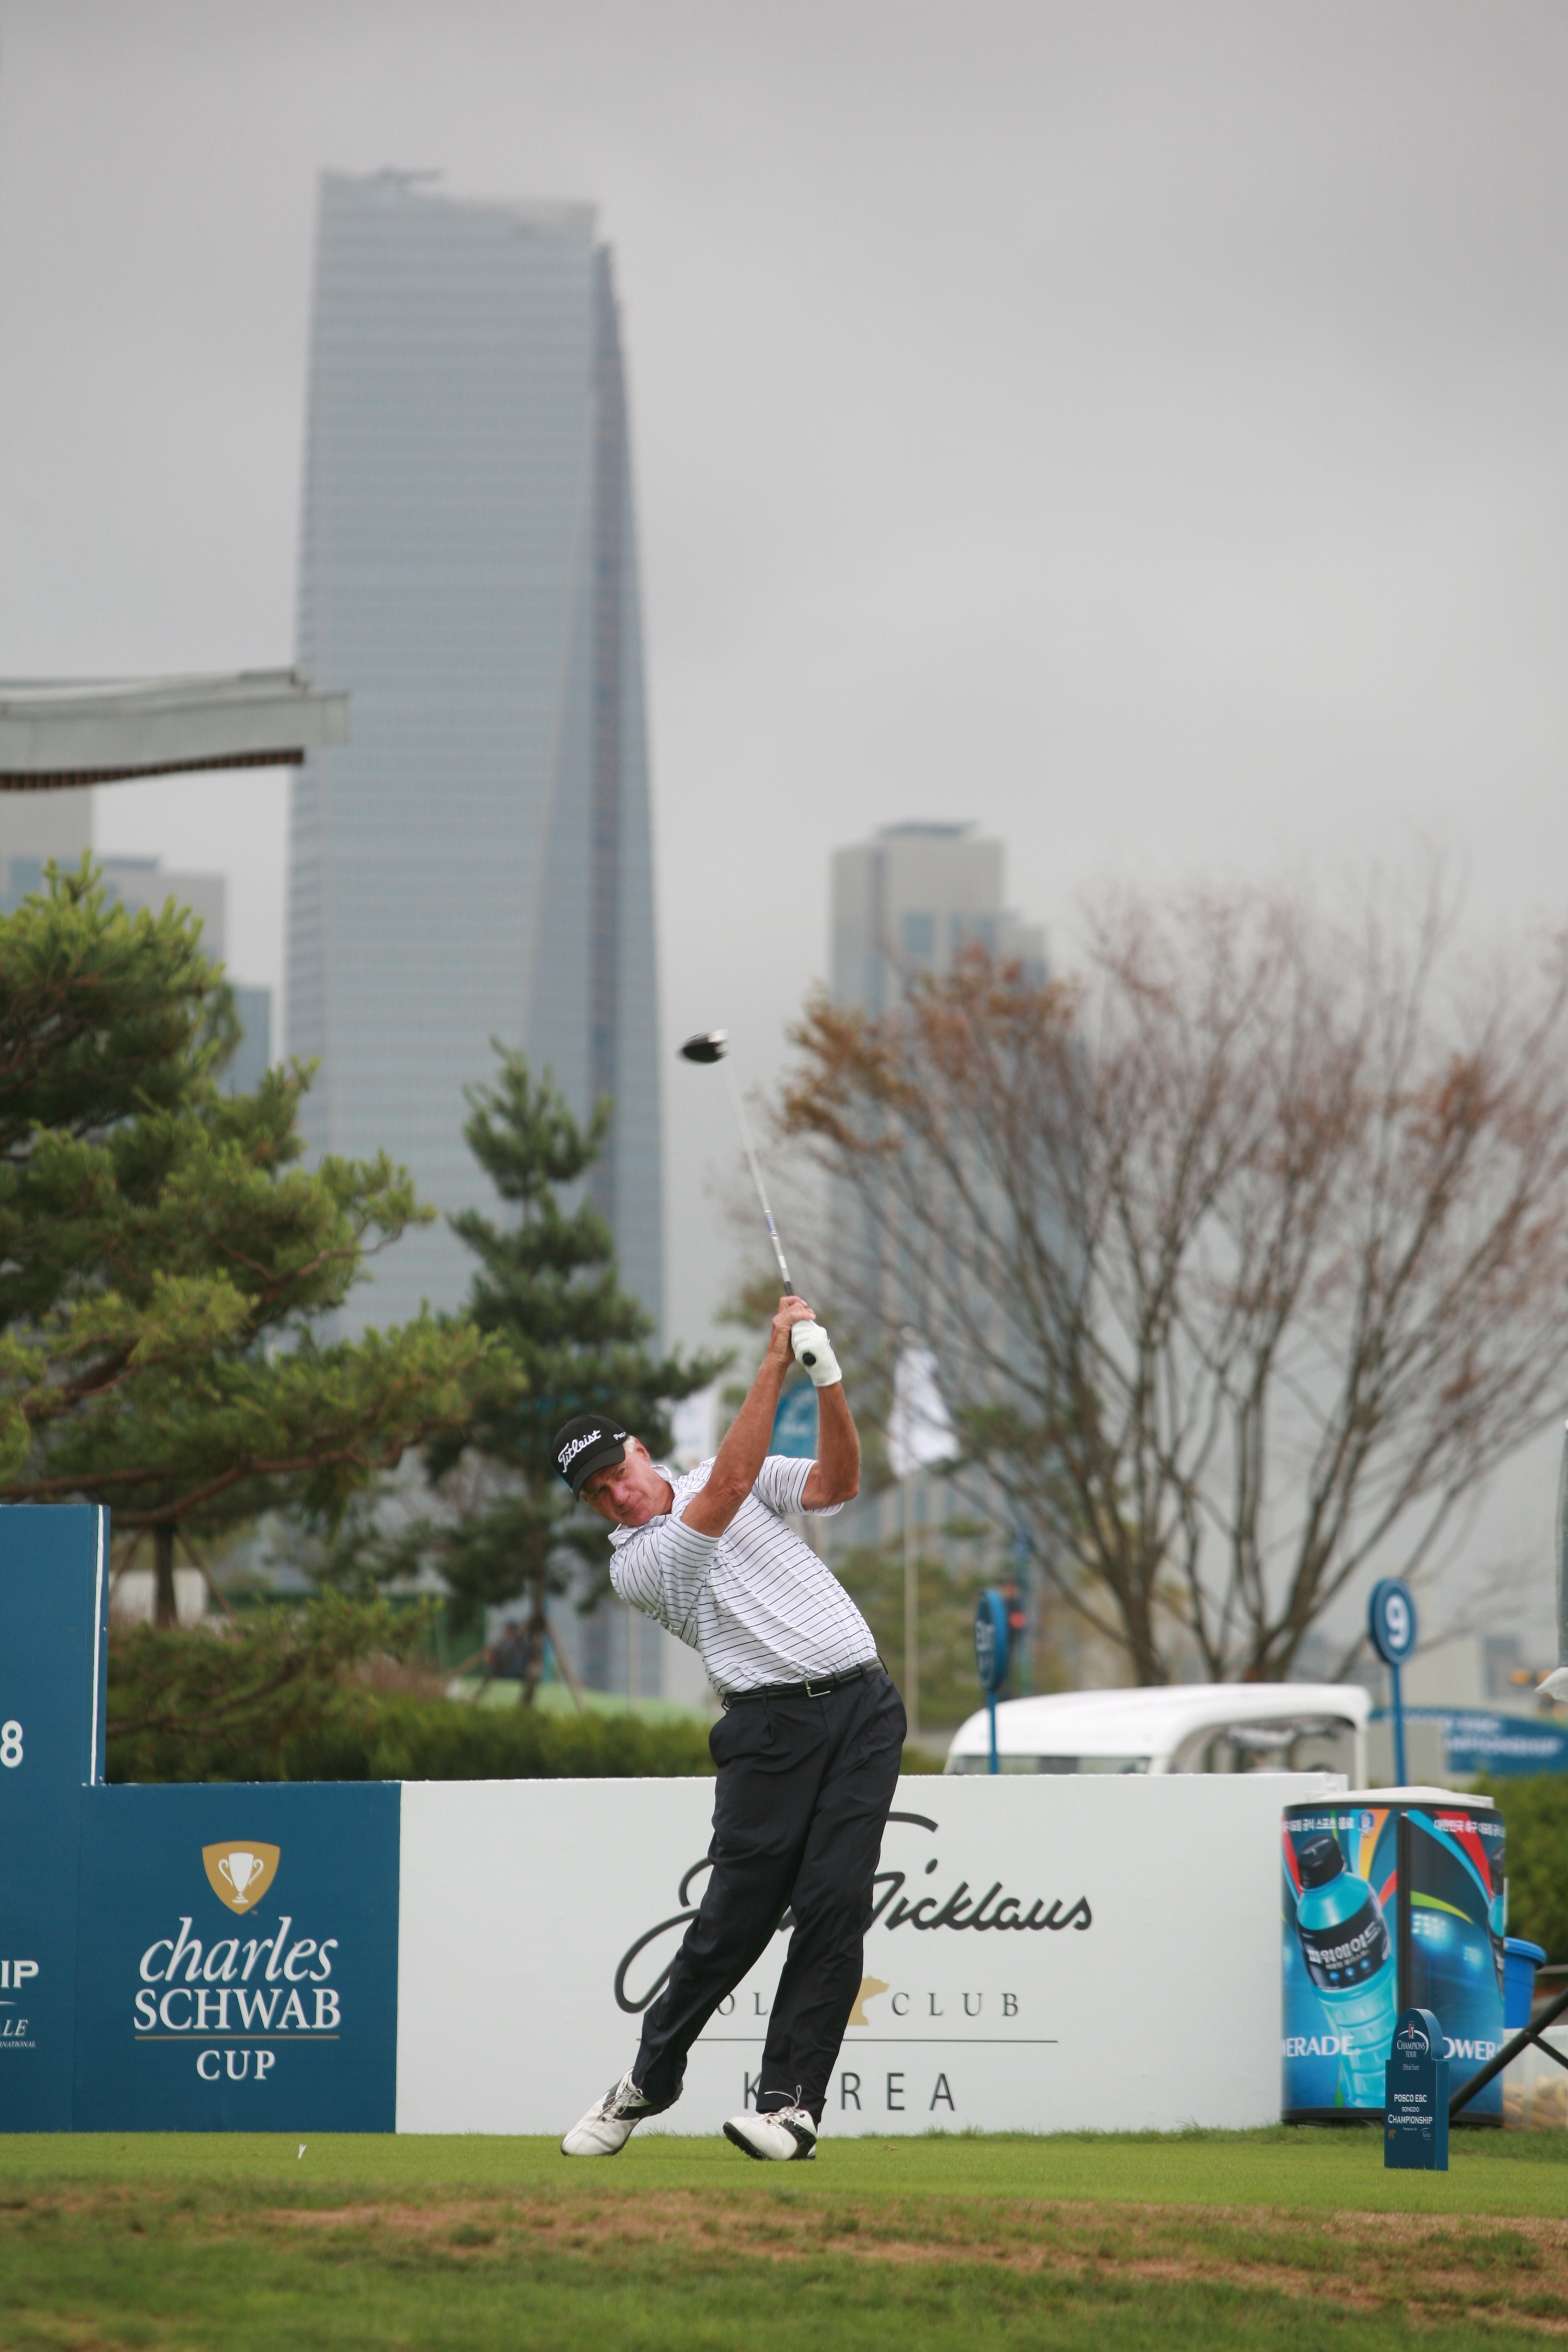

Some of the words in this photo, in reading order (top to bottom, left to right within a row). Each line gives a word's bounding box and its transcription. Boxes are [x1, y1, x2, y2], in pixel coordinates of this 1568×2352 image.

[558, 1430, 601, 1473] Titleist
[1385, 1594, 1411, 1648] 9
[0, 1719, 23, 1768] 8
[139, 1916, 339, 1982] charles
[1307, 1921, 1381, 1964] 파워에이드
[133, 1988, 341, 2031] SCHWAB
[717, 1992, 768, 2015] OL
[891, 1992, 1018, 2016] CLUB
[196, 2050, 275, 2080] CUP
[1397, 2040, 1426, 2050] CHAMPIONS
[744, 2071, 955, 2111] KREA
[1394, 2094, 1414, 2102] POSCO
[1415, 2094, 1427, 2103] E&C
[1388, 2113, 1433, 2124] CHAMPIONSHIP
